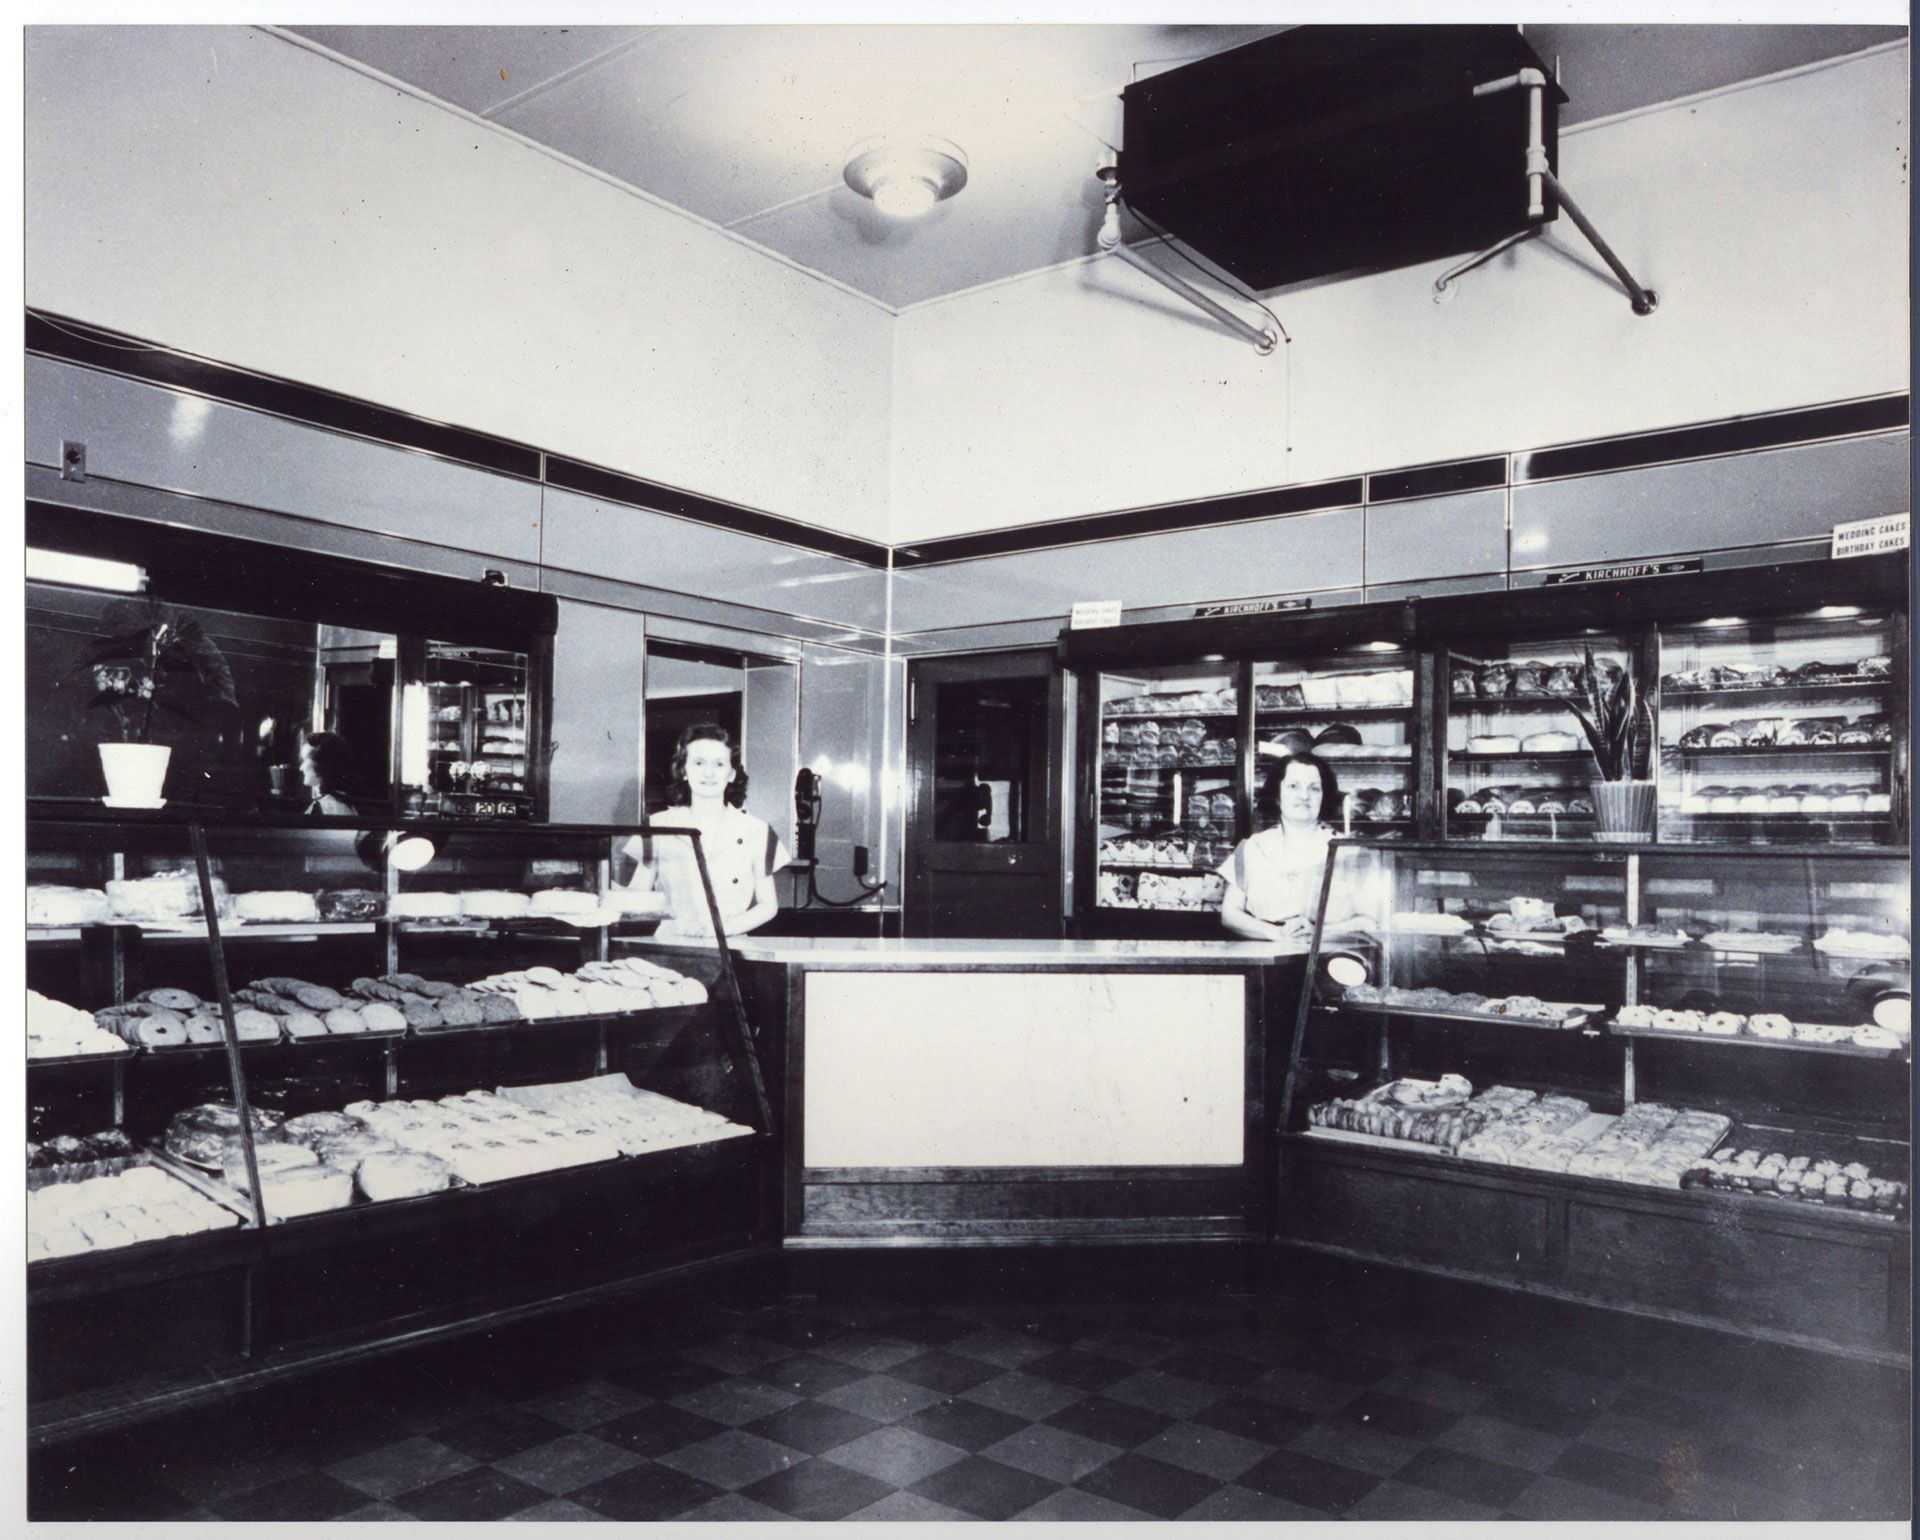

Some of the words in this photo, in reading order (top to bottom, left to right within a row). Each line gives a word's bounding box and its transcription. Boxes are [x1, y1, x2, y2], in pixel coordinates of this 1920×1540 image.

[1838, 527, 1875, 541] WEDDING
[1879, 522, 1906, 534] CAKES
[1837, 542, 1875, 556] BIRTHDAY
[1879, 537, 1905, 549] CAKES
[1585, 564, 1660, 581] KIRCHHOFF'S
